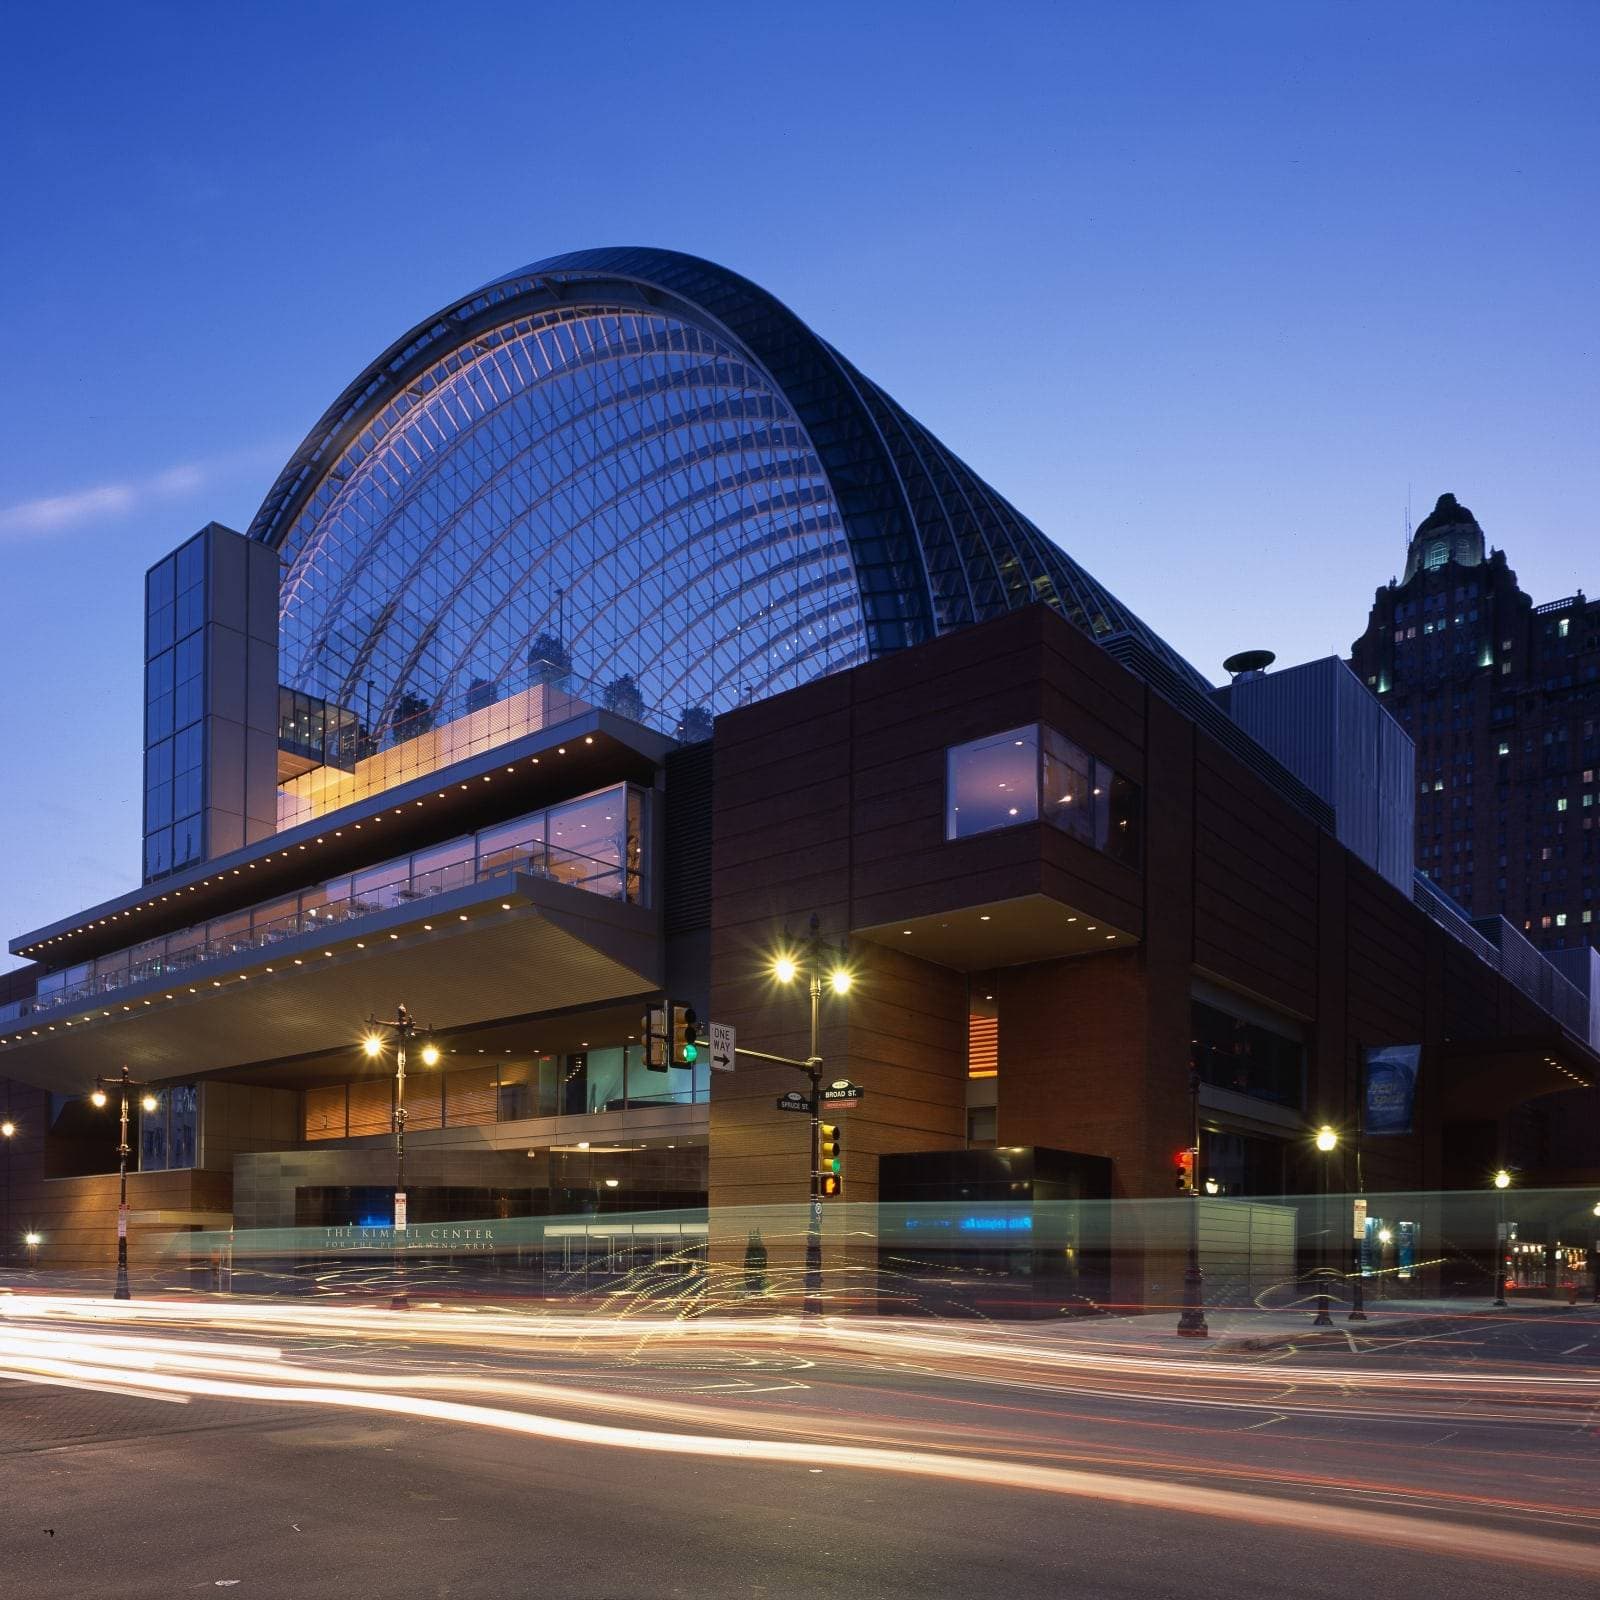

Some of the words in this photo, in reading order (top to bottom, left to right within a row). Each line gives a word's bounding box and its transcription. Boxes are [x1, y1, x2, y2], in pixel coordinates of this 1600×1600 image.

[714, 1028, 730, 1040] ONE
[713, 1040, 730, 1052] WAY
[825, 1090, 846, 1098] BROAD
[847, 1089, 857, 1097] ST.
[781, 1101, 800, 1109] SPRUCE
[325, 1228, 352, 1237] THE
[430, 1229, 494, 1239] CENTER
